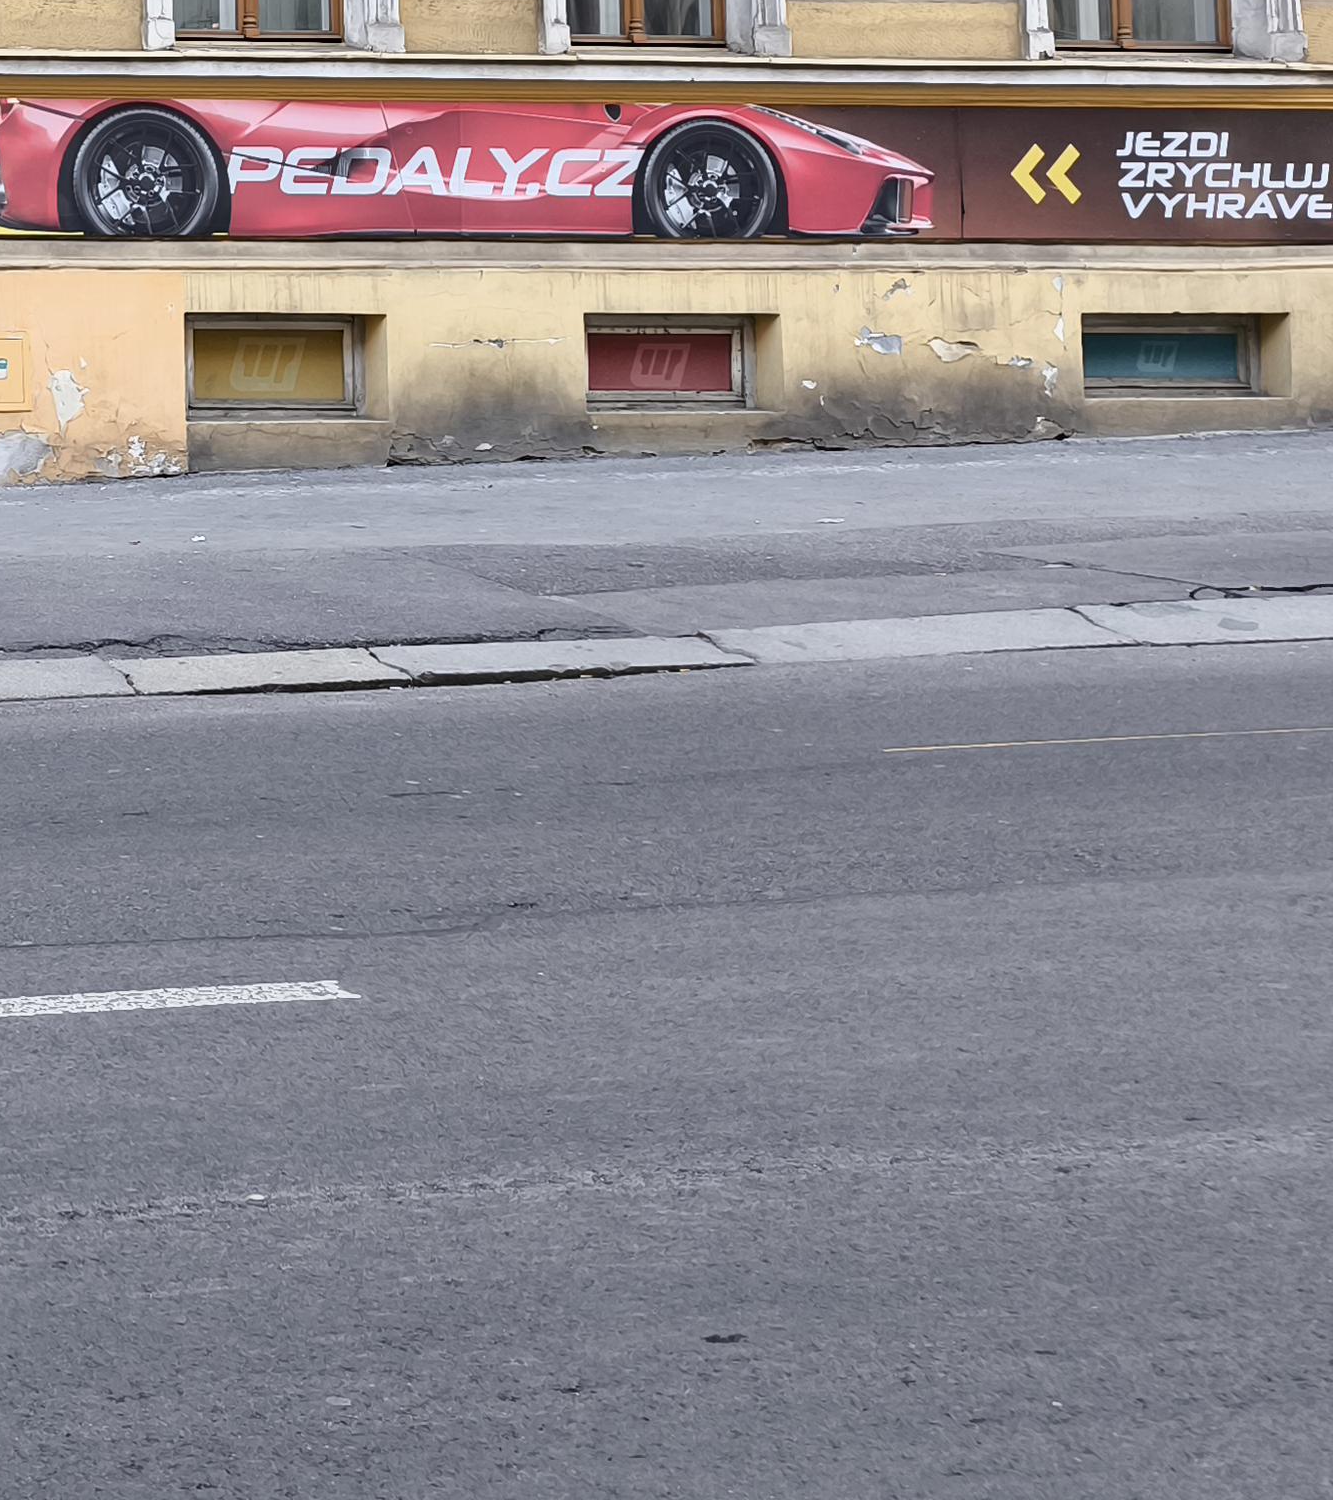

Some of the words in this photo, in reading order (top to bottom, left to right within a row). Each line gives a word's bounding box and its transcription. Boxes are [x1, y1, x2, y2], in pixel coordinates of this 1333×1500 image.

[1116, 131, 1230, 158] JEZDI
[227, 146, 645, 196] PEDALY.CZ
[1118, 162, 1330, 189] ZRYCHLUJ
